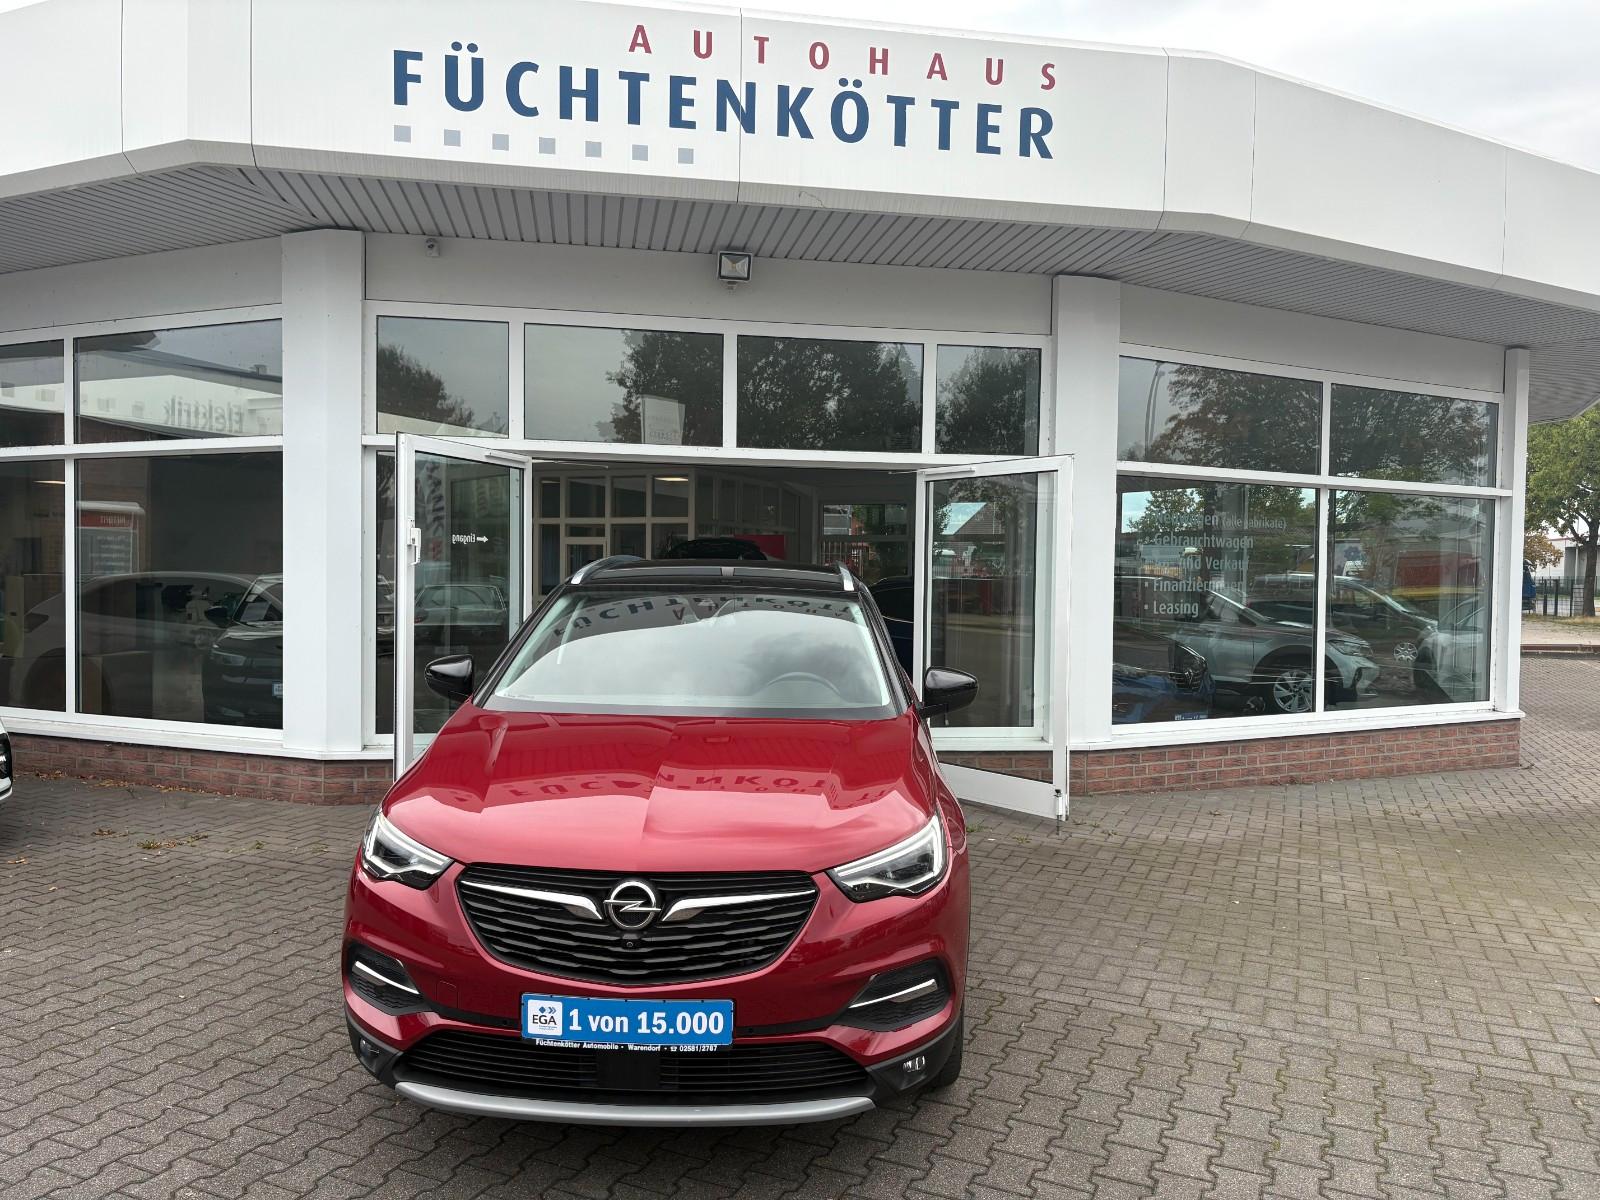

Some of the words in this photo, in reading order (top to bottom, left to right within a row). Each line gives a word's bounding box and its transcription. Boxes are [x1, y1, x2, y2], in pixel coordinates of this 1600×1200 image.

[628, 24, 1057, 90] AUTOHAUS
[392, 41, 1054, 159] FÜCHTENKÖTTER
[1153, 599, 1199, 618] Leasing
[532, 1014, 557, 1026] EGA
[569, 1008, 582, 1031] 1
[588, 1014, 629, 1033] von
[637, 1011, 725, 1035] 15.000
[582, 1041, 619, 1051] Automobile
[628, 1044, 661, 1052] Warendorf
